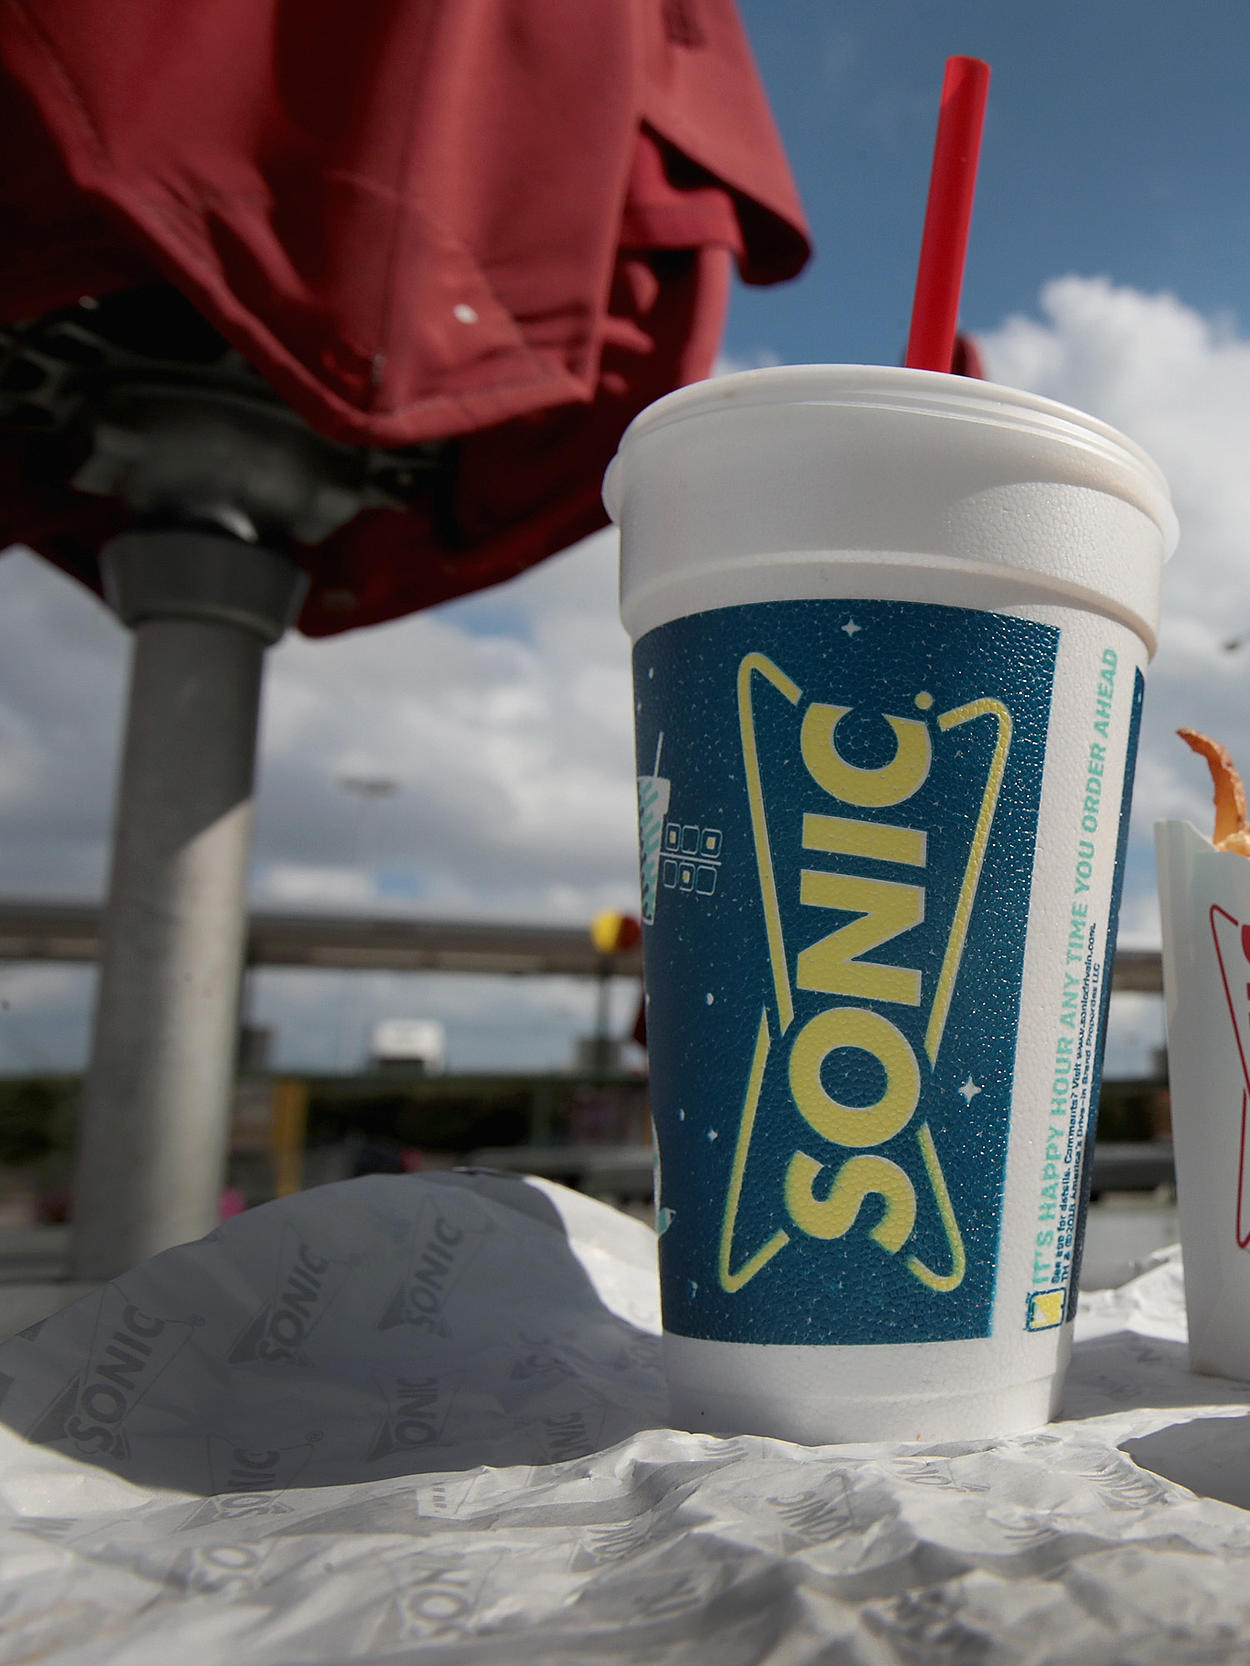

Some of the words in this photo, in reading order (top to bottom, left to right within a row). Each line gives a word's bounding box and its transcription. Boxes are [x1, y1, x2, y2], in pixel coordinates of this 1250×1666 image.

[1094, 648, 1118, 738] AHEAD
[1081, 743, 1106, 833] ORDER
[1074, 840, 1096, 895] YOU
[1066, 902, 1089, 965] TIME
[788, 702, 933, 1254] SONIC
[1060, 972, 1080, 1029] ANY
[1081, 1050, 1092, 1085] Brand
[1093, 962, 1101, 984] LLC
[1050, 1037, 1074, 1116] HOUR
[1072, 1062, 1082, 1089] Visit
[1064, 1092, 1079, 1164] Comments?
[1038, 1125, 1064, 1222] HAPPY
[1059, 1167, 1071, 1211] details.
[1032, 1229, 1055, 1284] IT'S
[1057, 1215, 1067, 1232] for
[64, 1303, 166, 1454] SONIC
[395, 1376, 440, 1445] ONIC
